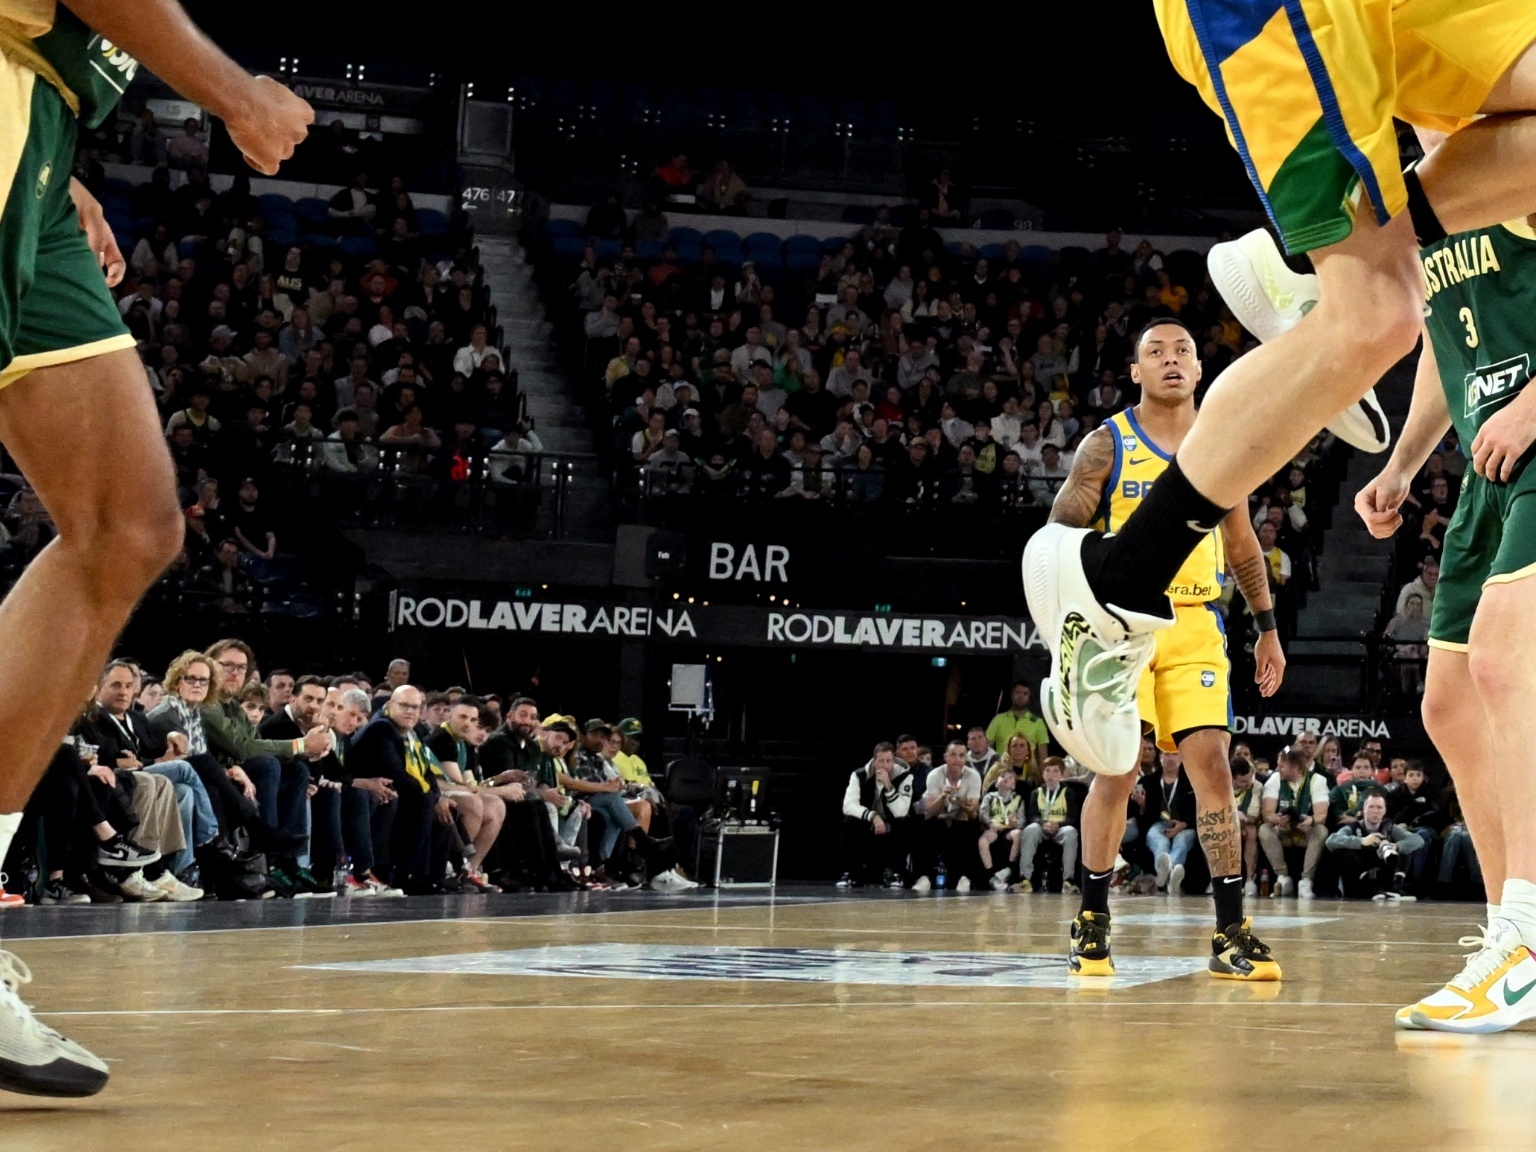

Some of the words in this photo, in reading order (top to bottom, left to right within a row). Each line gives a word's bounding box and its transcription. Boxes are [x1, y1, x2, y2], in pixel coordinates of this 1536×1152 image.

[293, 85, 383, 105] AVERARENA
[462, 187, 490, 202] 476
[1459, 307, 1479, 348] 3
[708, 542, 790, 583] BAR
